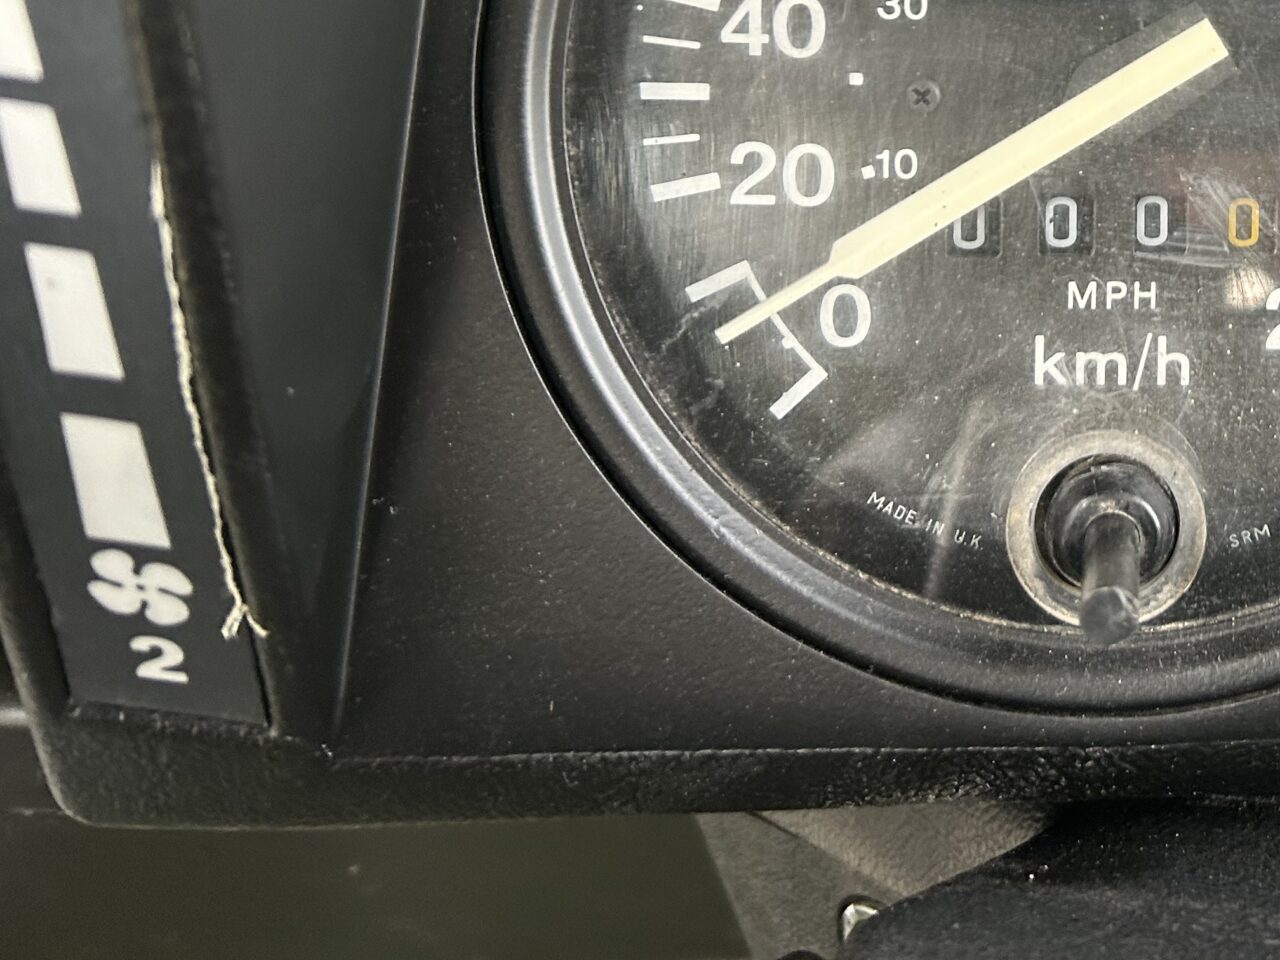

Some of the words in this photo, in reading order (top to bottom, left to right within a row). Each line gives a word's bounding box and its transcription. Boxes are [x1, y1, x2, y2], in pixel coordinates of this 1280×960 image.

[730, 142, 835, 207] 20
[874, 149, 918, 180] 10
[820, 284, 872, 347] 0
[1067, 281, 1157, 310] MPH
[1034, 332, 1190, 390] km/h
[866, 491, 917, 525] MADE
[925, 518, 945, 536] IN
[1229, 524, 1271, 548] SRM
[129, 635, 190, 685] 2
